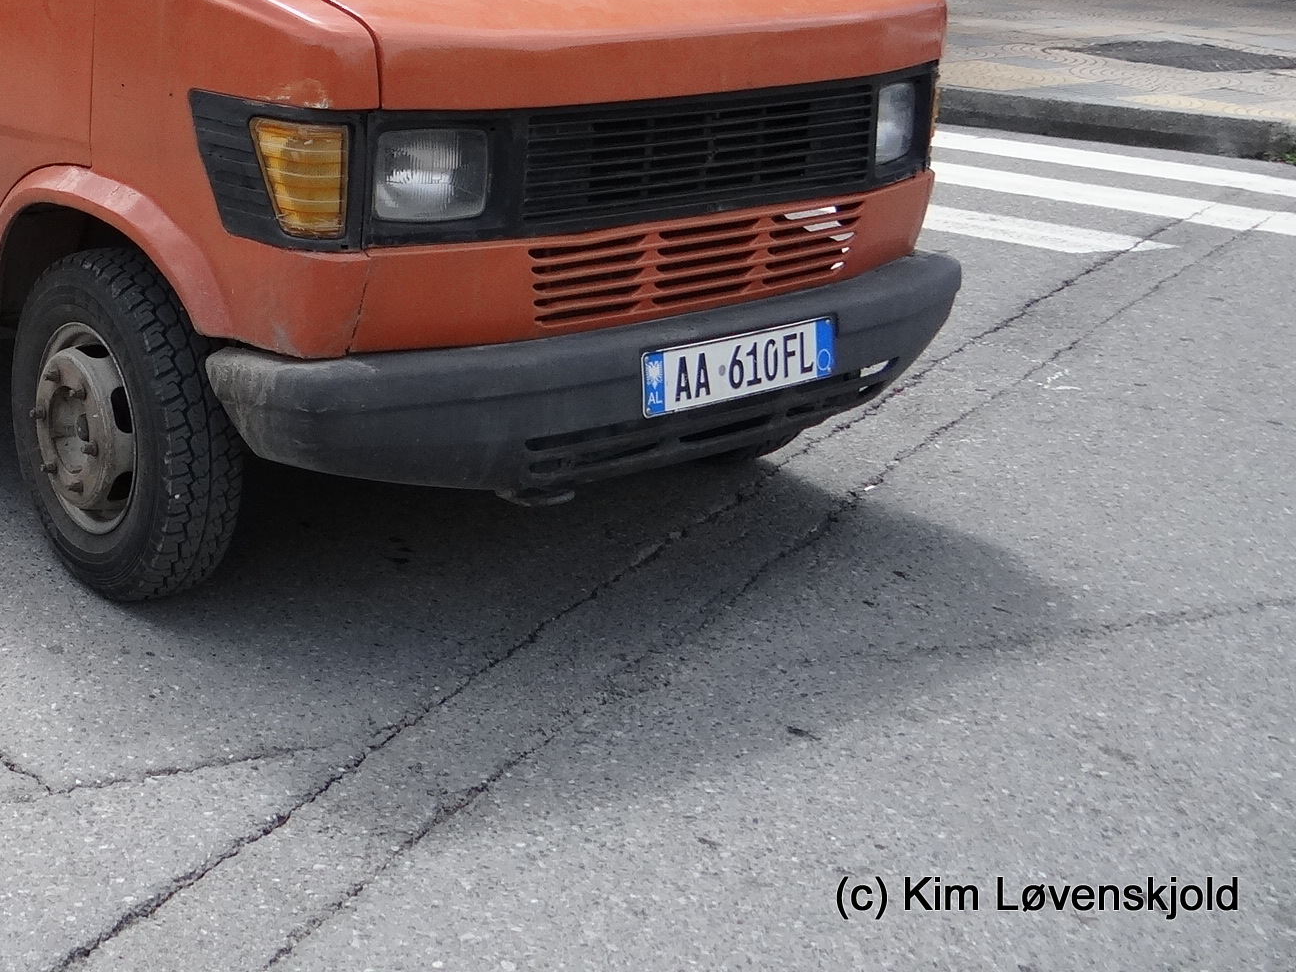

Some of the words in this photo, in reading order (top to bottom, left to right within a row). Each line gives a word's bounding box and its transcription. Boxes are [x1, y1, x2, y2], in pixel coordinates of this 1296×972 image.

[675, 352, 711, 403] AA
[728, 331, 814, 390] 610FL
[647, 392, 663, 405] AL
